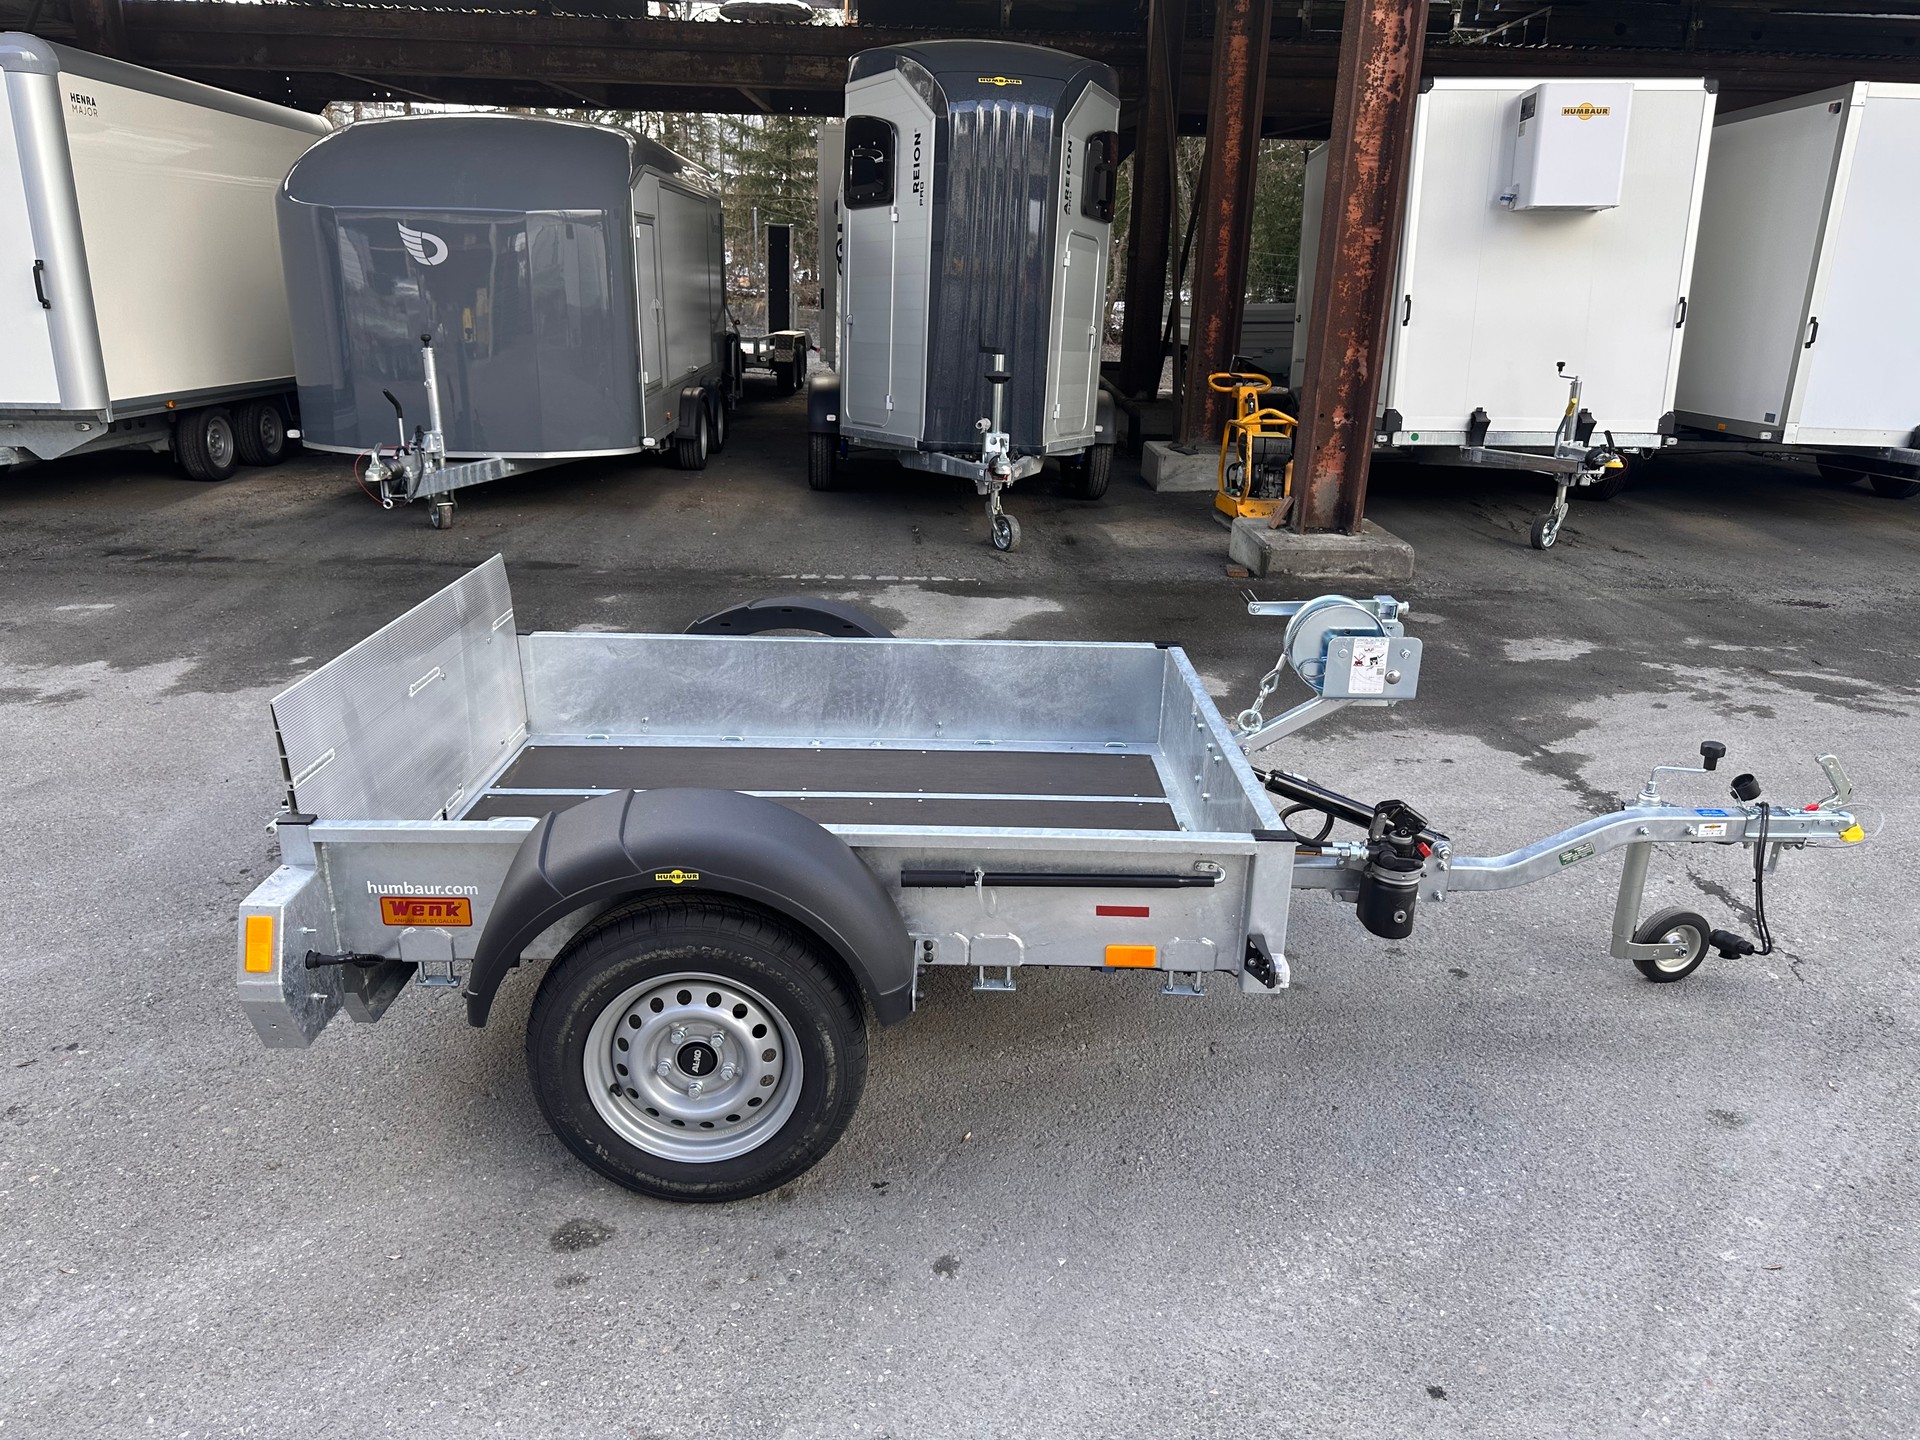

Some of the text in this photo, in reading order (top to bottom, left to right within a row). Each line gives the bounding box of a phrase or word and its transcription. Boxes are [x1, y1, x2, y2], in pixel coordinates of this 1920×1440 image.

[70, 92, 97, 107] HENRA
[71, 104, 98, 117] MAJOR
[912, 131, 921, 193] REION
[1063, 139, 1072, 215] AREION
[366, 880, 479, 895] humbaur.com
[389, 901, 461, 917] Wenk
[691, 1049, 702, 1073] AL-KO
